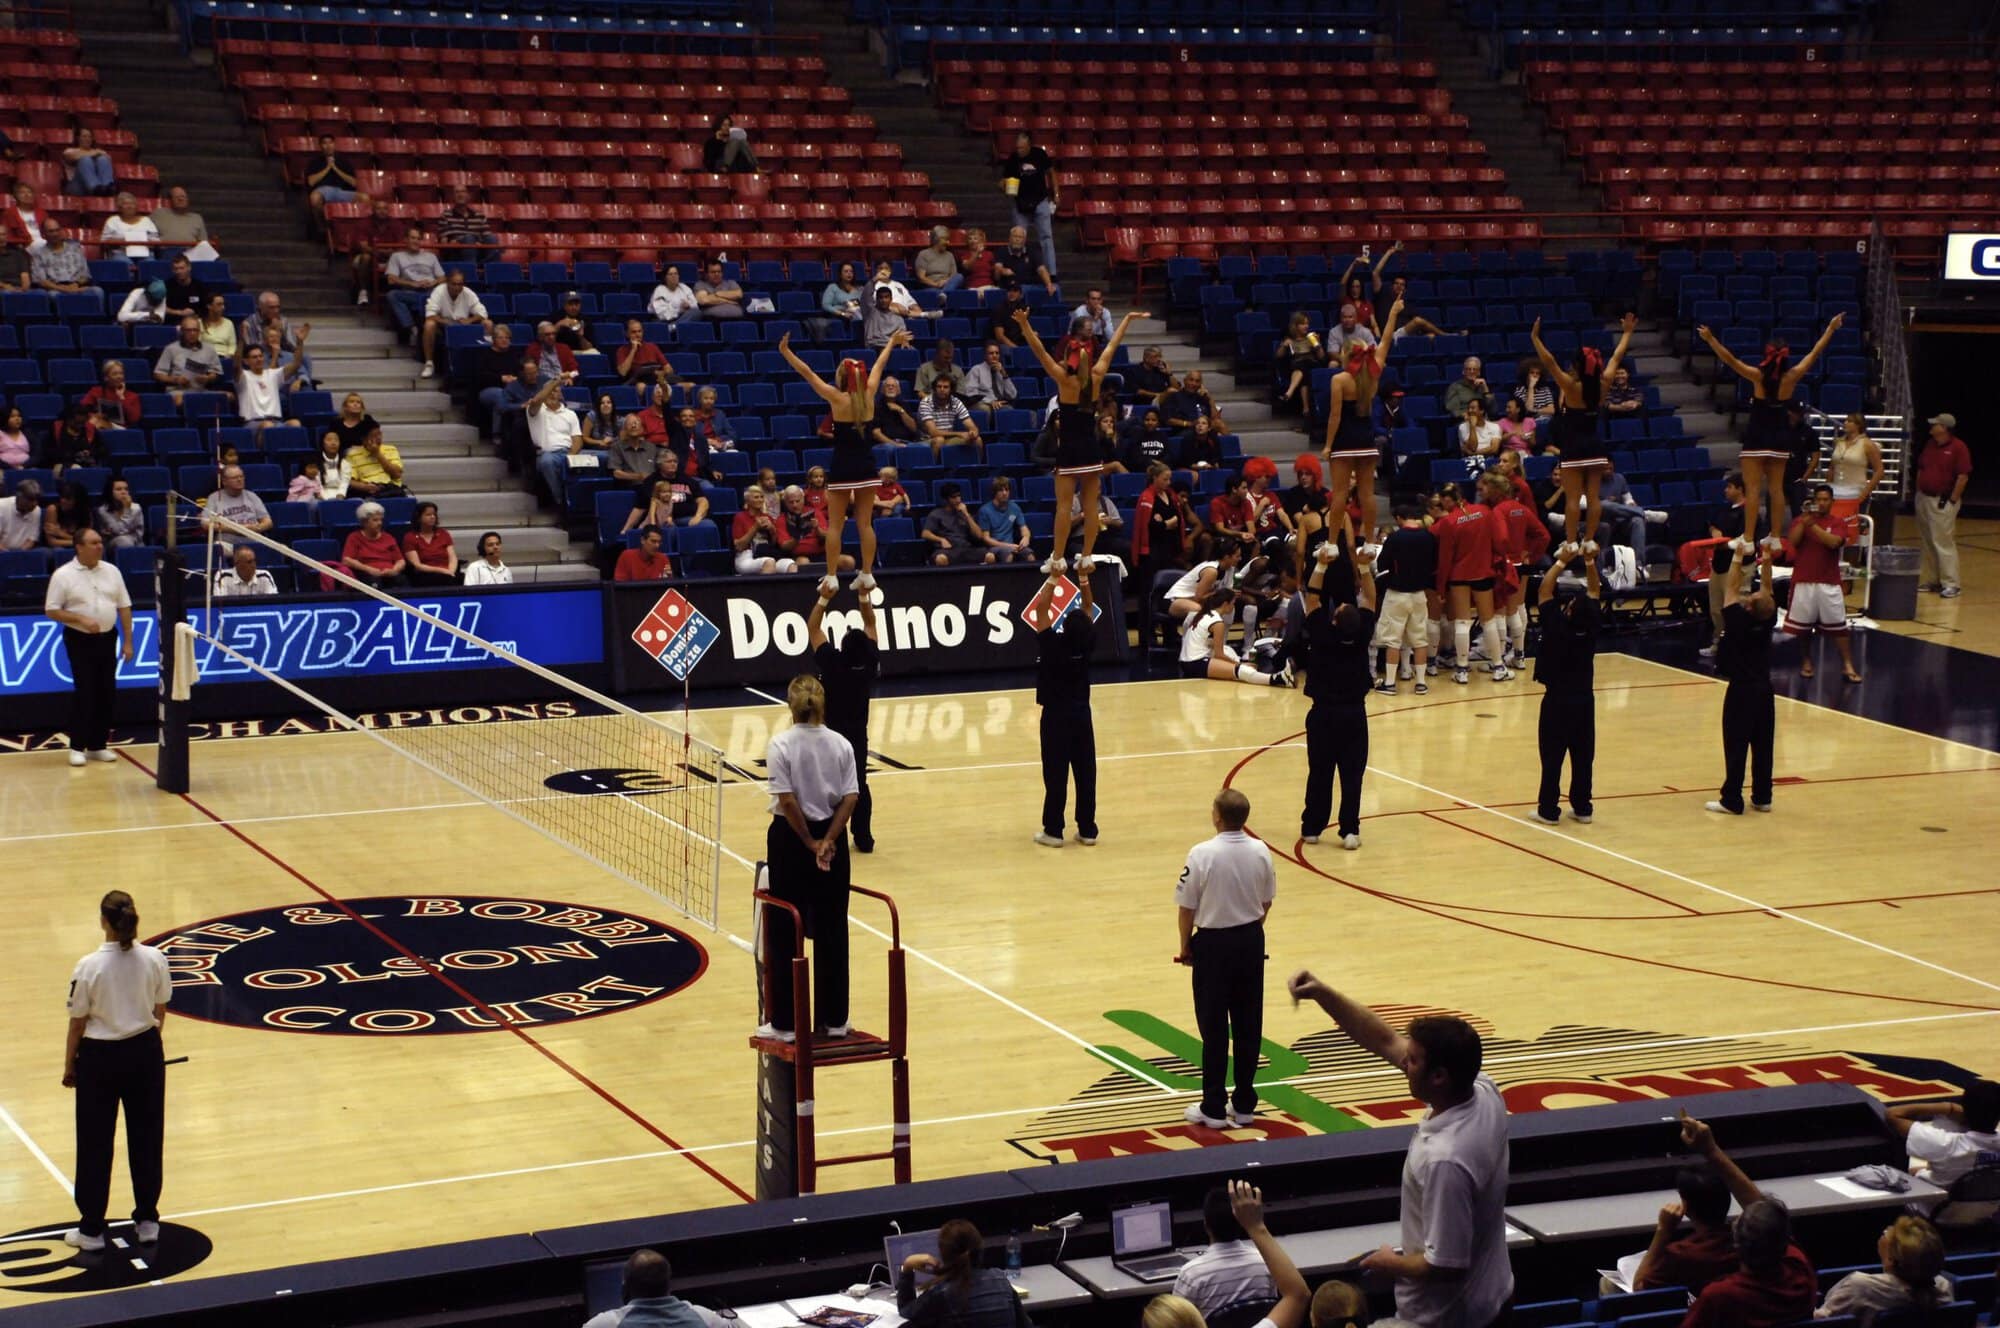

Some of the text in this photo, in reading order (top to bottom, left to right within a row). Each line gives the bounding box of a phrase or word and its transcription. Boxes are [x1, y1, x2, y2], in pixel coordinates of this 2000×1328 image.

[530, 35, 539, 49] 4
[1180, 49, 1188, 62] 5
[1806, 49, 1815, 61] 6
[1856, 241, 1866, 254] 6
[0, 601, 487, 687] VLEYBALL
[661, 617, 704, 666] Domino's
[672, 644, 702, 676] Pizza
[1179, 866, 1190, 884] 2
[401, 898, 678, 948] BOBBI
[243, 940, 600, 990] OLSON
[262, 974, 665, 1033] COURT
